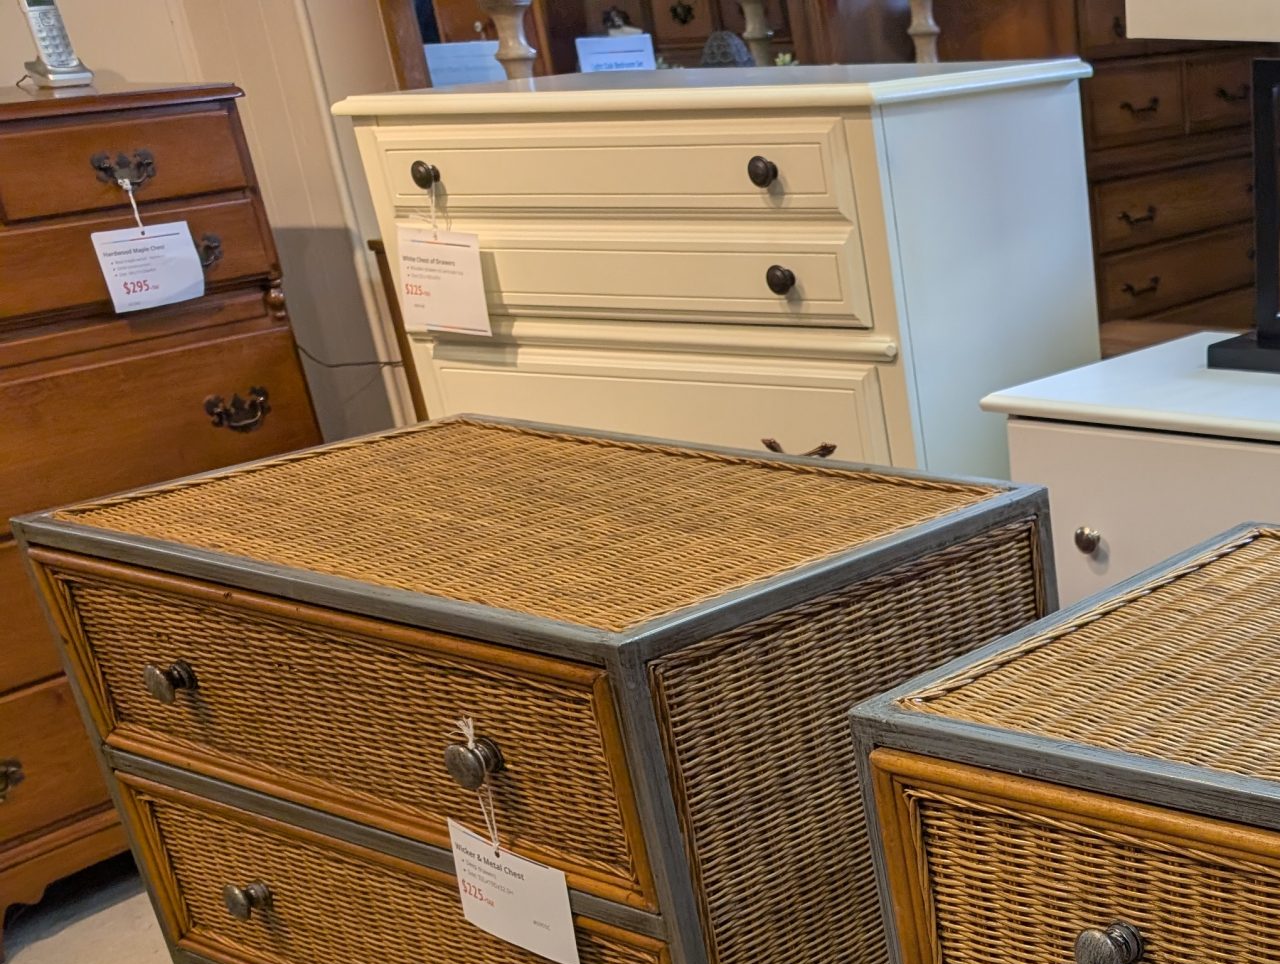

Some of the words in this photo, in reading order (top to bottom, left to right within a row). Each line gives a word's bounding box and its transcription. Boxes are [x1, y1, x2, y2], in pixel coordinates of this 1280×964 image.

[454, 842, 476, 859] Wicker
[477, 854, 482, 862] &
[483, 856, 503, 872] Metal
[504, 866, 525, 881] Chest
